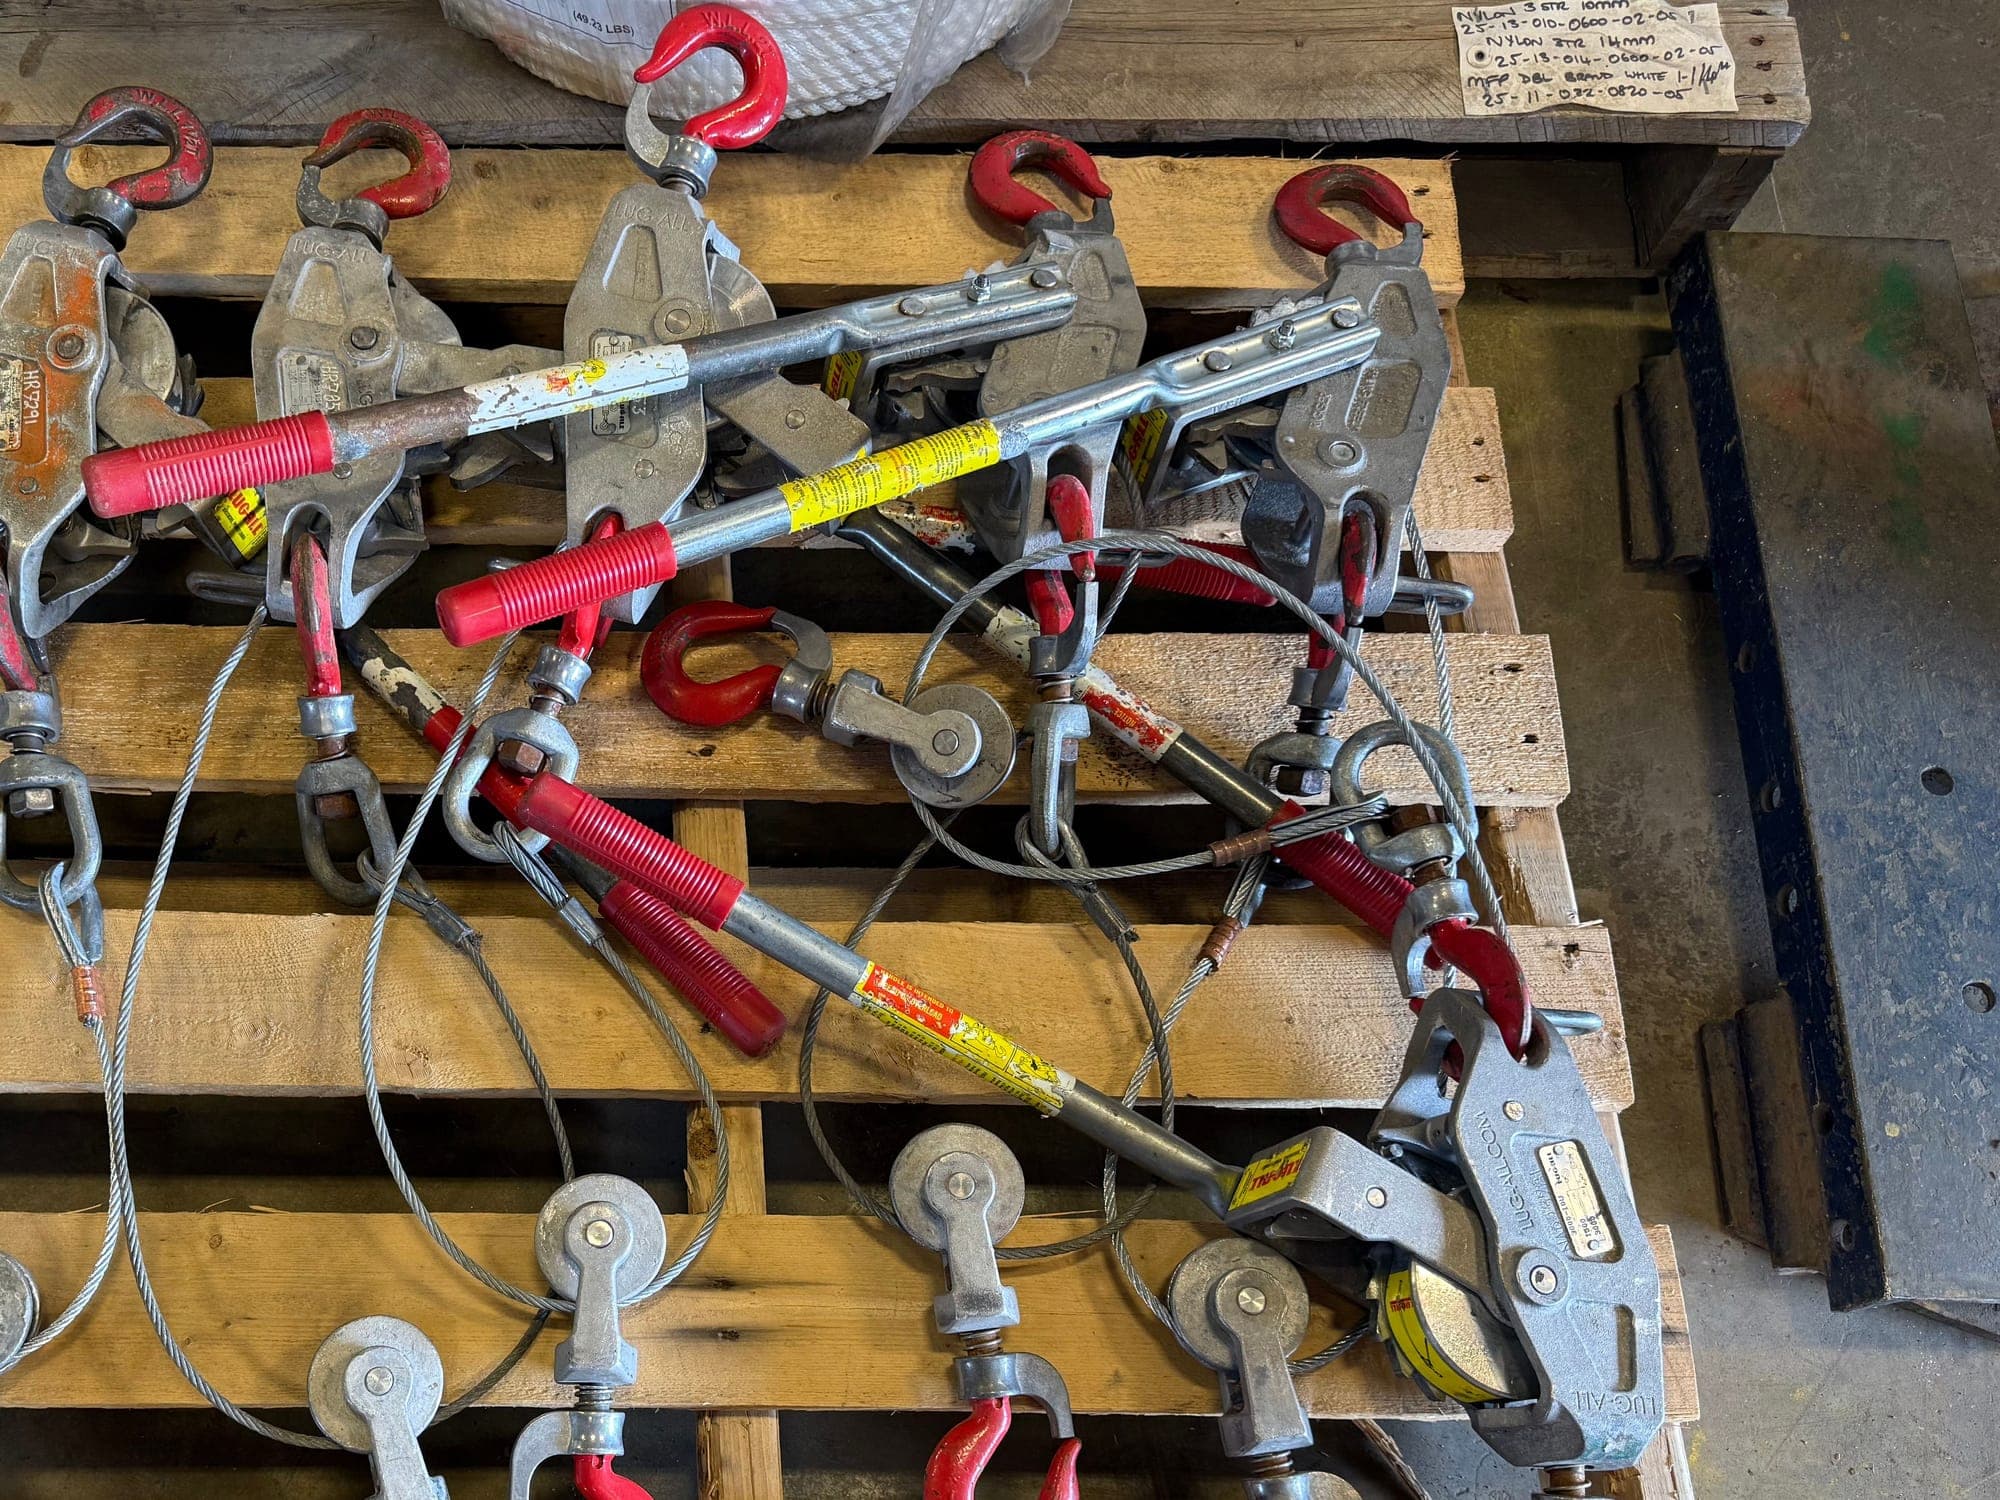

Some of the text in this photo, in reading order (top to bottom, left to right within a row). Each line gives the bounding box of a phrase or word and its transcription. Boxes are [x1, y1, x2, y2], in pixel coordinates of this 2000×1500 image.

[1457, 7, 1516, 22] NYLON
[1524, 2, 1537, 12] 3
[1541, 1, 1569, 11] STR
[573, 10, 635, 37] (49.23 LBS)
[1486, 35, 1543, 47] NYLON
[1625, 70, 1668, 81] WHITE
[1112, 706, 1138, 728] NOTICE
